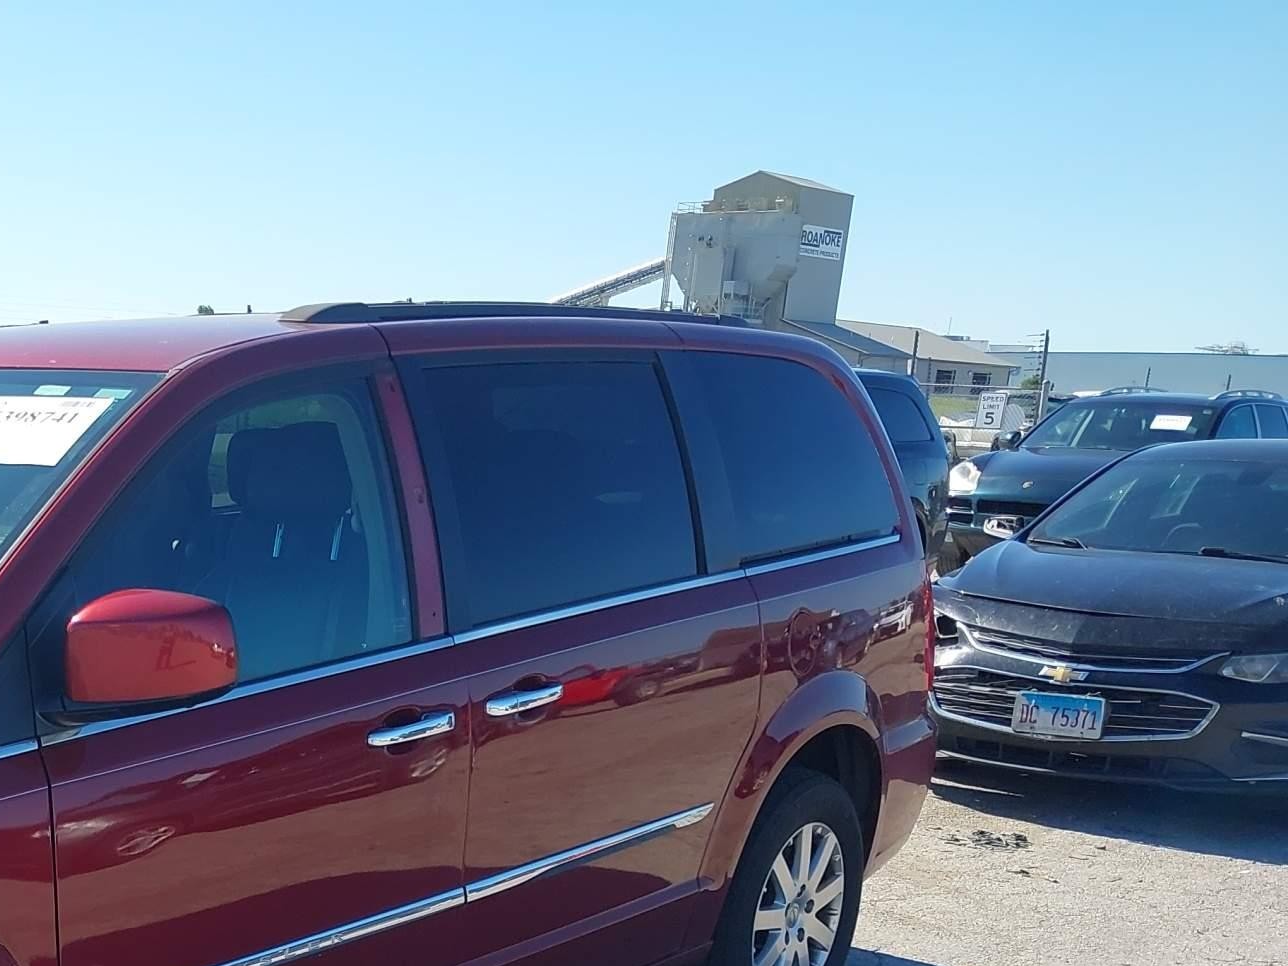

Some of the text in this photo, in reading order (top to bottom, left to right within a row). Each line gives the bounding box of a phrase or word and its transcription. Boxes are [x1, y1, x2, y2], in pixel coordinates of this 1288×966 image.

[800, 229, 842, 248] ROANOKE
[983, 412, 994, 425] 5
[1019, 703, 1097, 731] DC 75371
